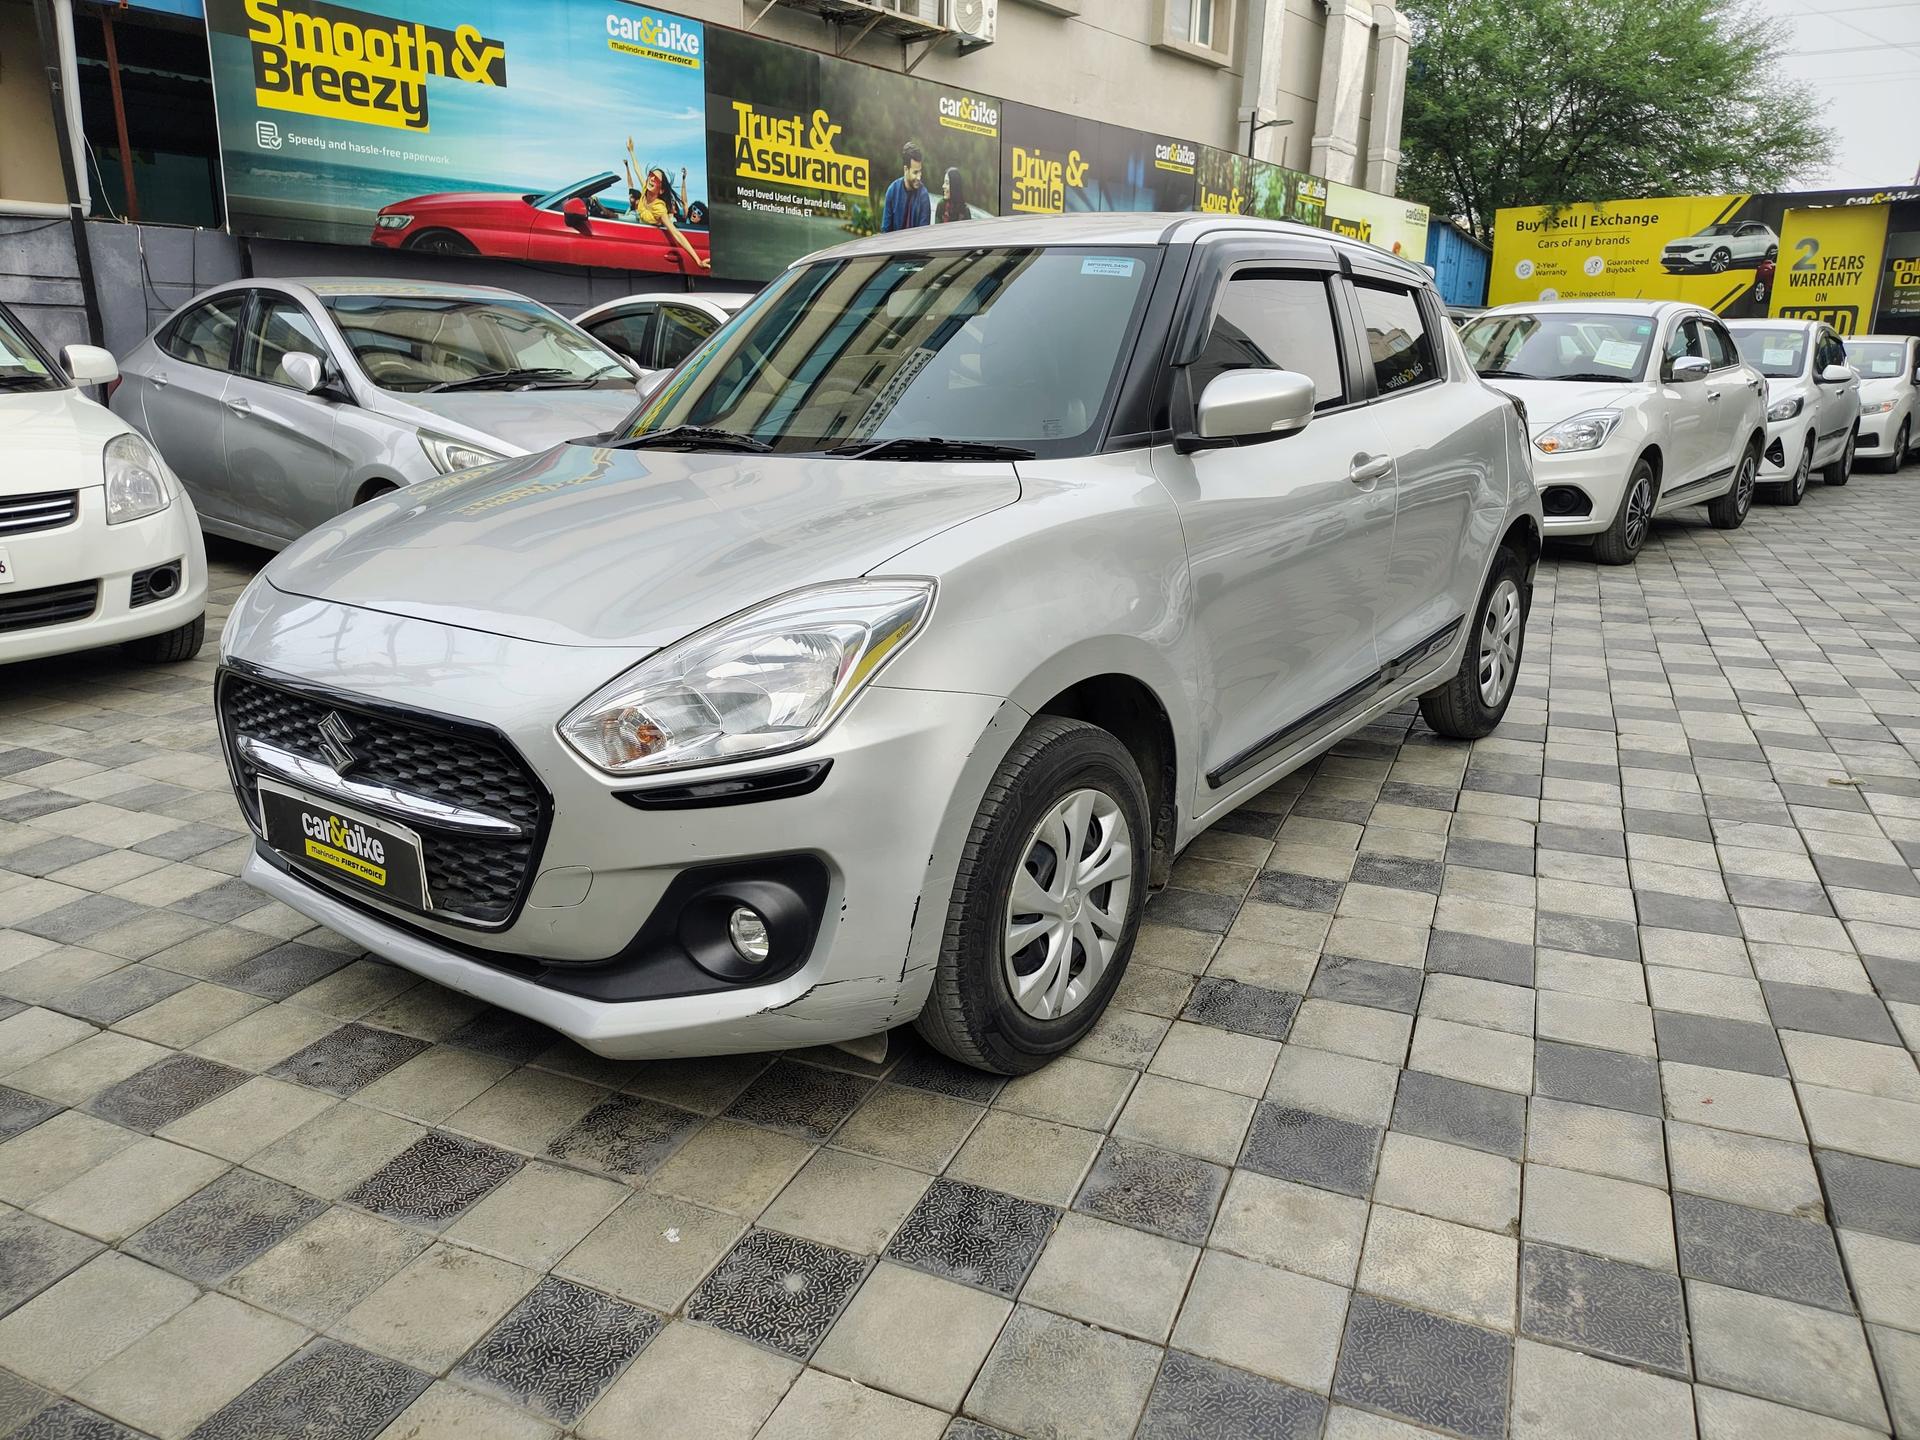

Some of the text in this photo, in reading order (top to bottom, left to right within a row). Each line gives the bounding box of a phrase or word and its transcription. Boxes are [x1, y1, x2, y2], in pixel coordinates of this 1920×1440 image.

[244, 0, 505, 86] Smooth &
[606, 14, 700, 55] car&bike
[647, 50, 667, 60] FIRST
[668, 55, 692, 65] CHOICE
[252, 43, 429, 128] Breezy
[939, 97, 997, 126] car&bike
[732, 101, 842, 154] Trust &
[288, 133, 326, 150] Speedy
[328, 140, 347, 150] and
[349, 141, 401, 158] hassle-free
[1155, 144, 1195, 165] car&bike
[736, 138, 866, 190] Assurance
[1012, 147, 1089, 188] Drive &
[737, 186, 846, 211] Most loved Used Car brand of India
[1012, 177, 1062, 210] Smile
[1201, 186, 1244, 215] Love &
[742, 199, 752, 210] By
[753, 201, 785, 214] Franchise
[785, 205, 804, 217] India,
[804, 208, 813, 217] ET
[1516, 220, 1541, 232] Buy
[1552, 215, 1578, 229] Sell
[1591, 213, 1659, 227] Exchange
[1538, 235, 1631, 249] Cars of any brands
[1791, 237, 1865, 271] 2 YEARS
[1535, 269, 1567, 277] Warranty
[1605, 266, 1636, 274] Buyback
[1789, 271, 1862, 288] WARRANTY
[1815, 292, 1828, 302] ON
[301, 812, 385, 865] car&bike
[341, 857, 359, 870] FIRST
[360, 864, 383, 880] CHOICE
